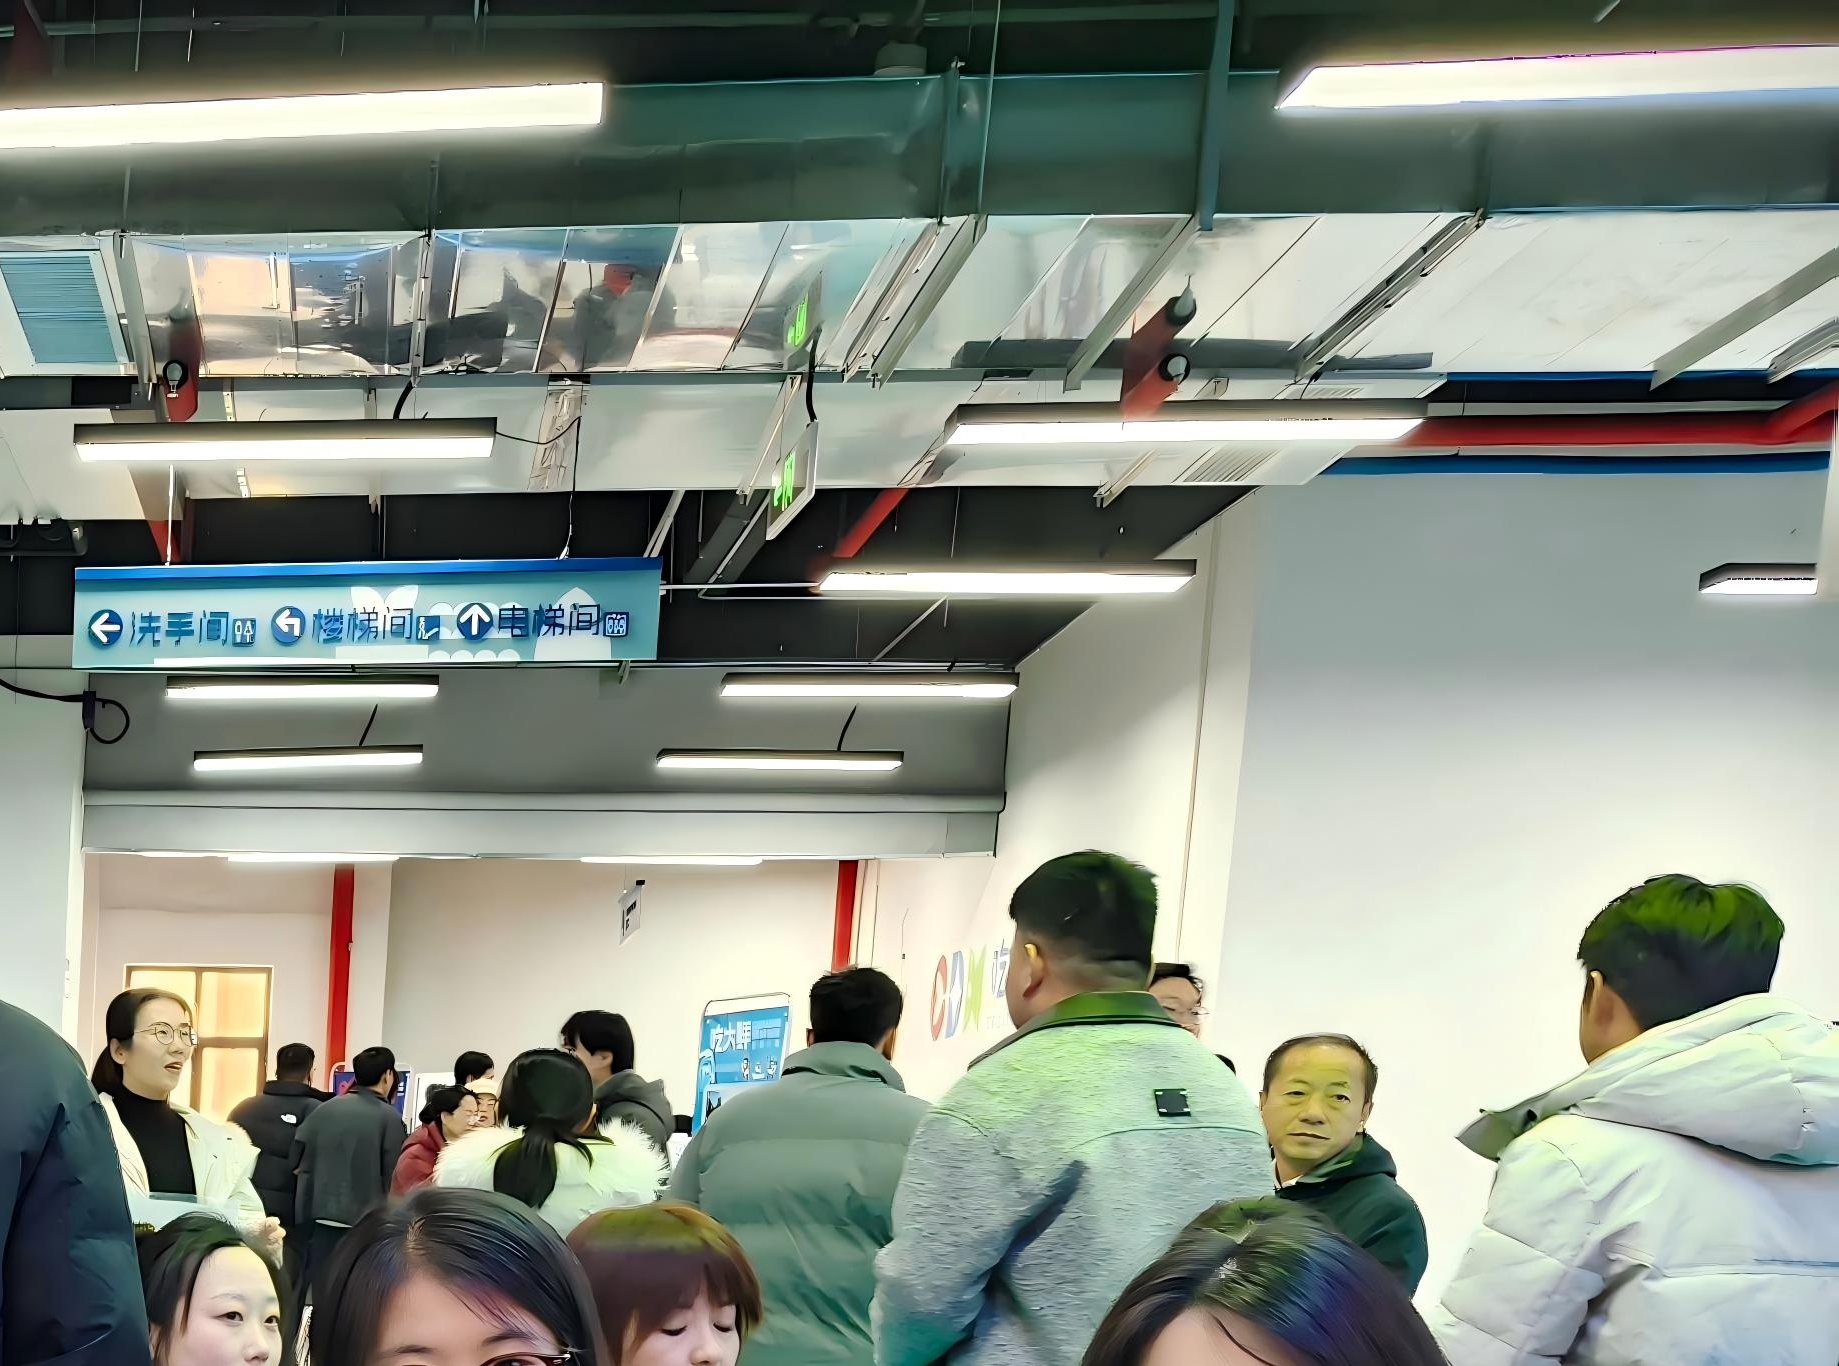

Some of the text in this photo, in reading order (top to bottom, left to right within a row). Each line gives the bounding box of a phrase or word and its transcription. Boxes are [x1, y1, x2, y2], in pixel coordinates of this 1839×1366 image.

[130, 610, 230, 648] 洗手间
[312, 605, 415, 644] 楼梯间
[497, 602, 602, 638] 电梯间
